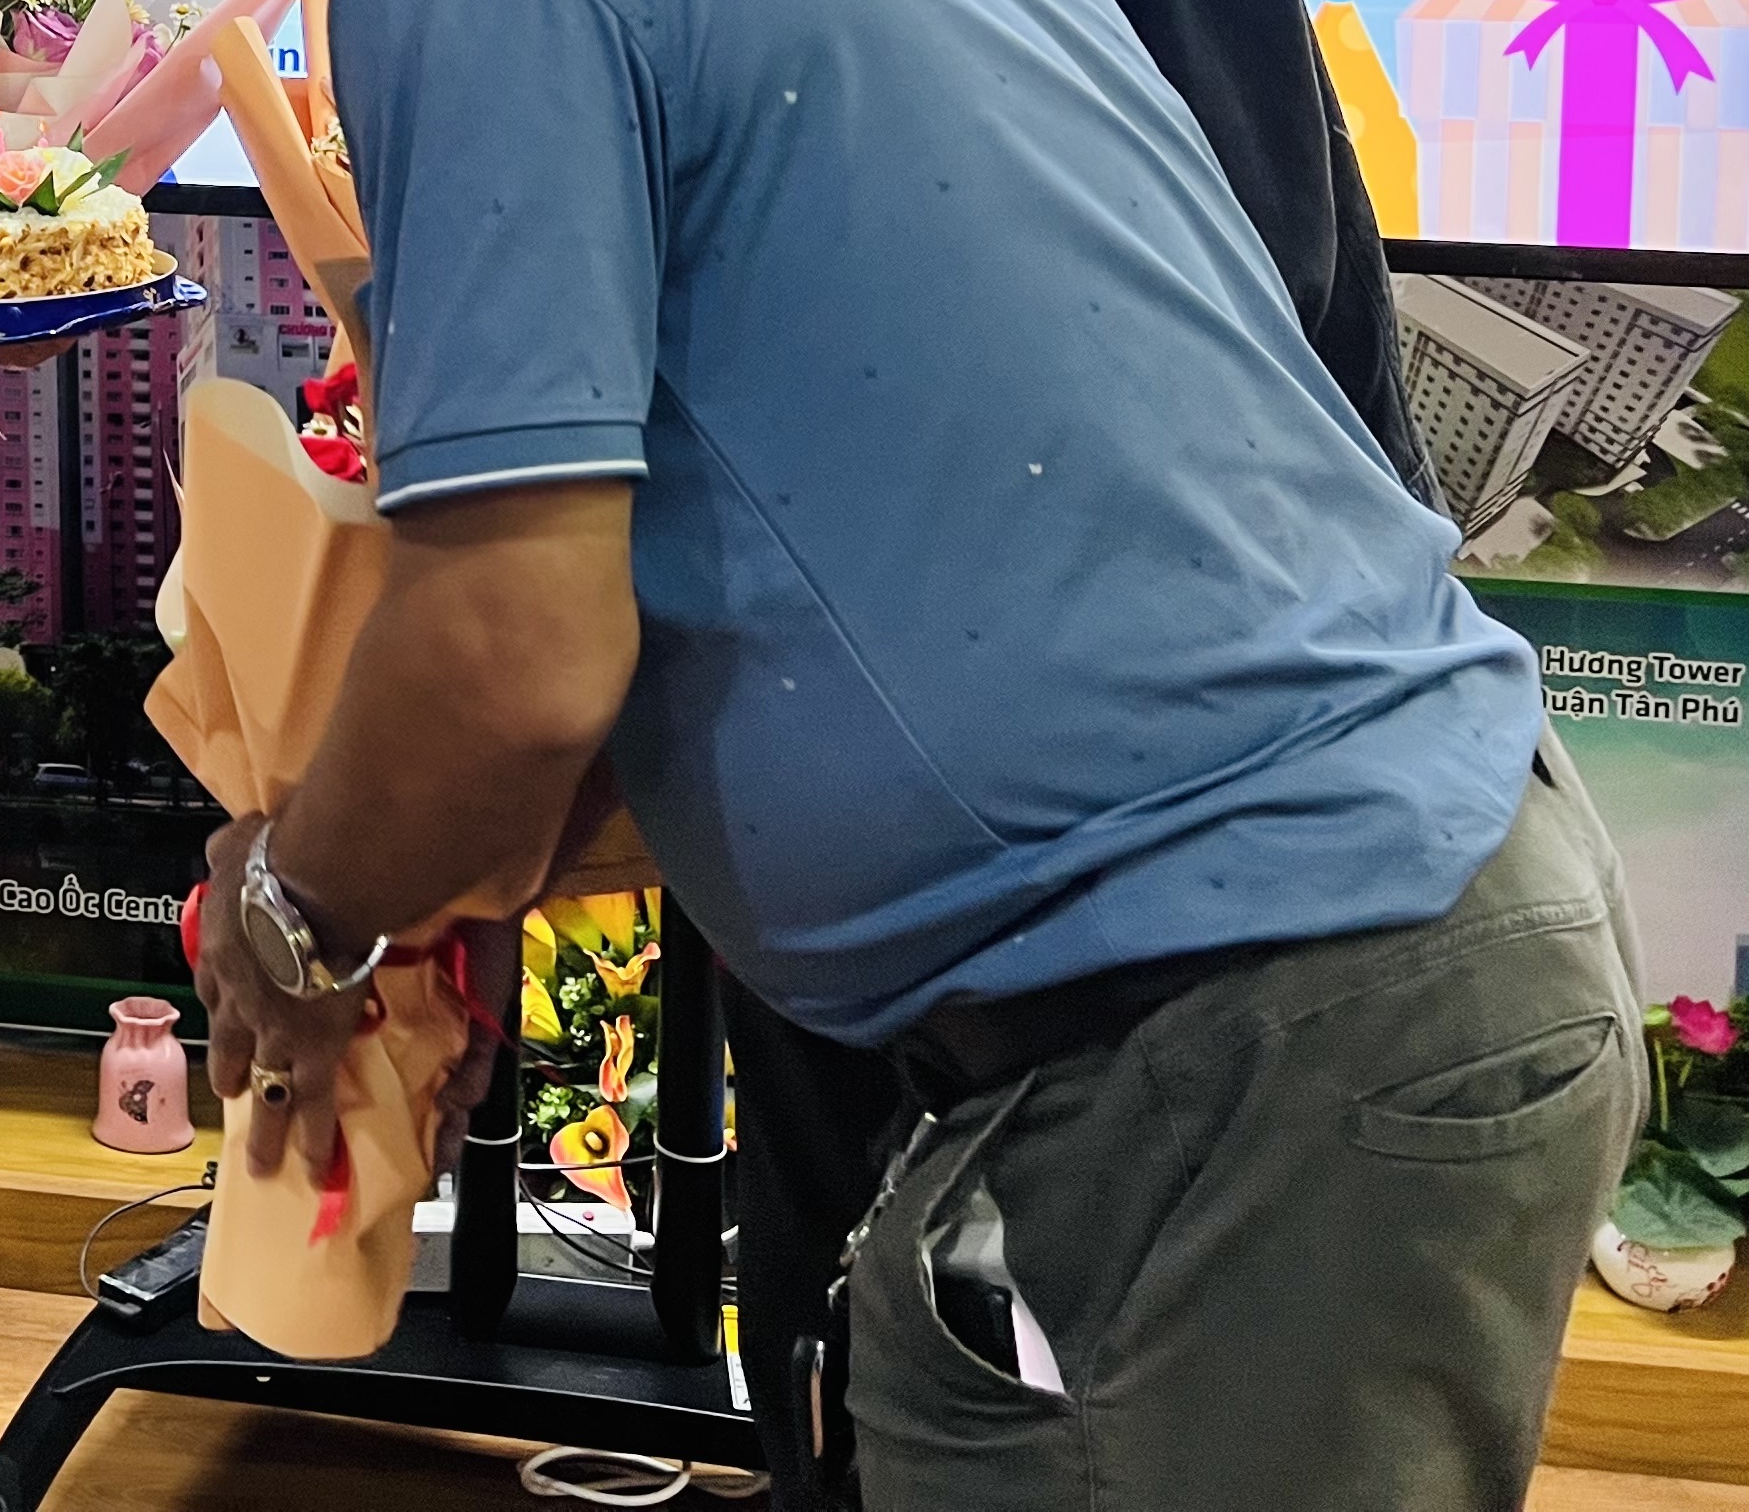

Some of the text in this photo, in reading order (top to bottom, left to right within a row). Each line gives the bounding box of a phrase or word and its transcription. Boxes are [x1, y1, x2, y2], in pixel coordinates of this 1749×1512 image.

[1544, 647, 1743, 685] Hương Tower
[1542, 687, 1740, 724] uận Tân Phú
